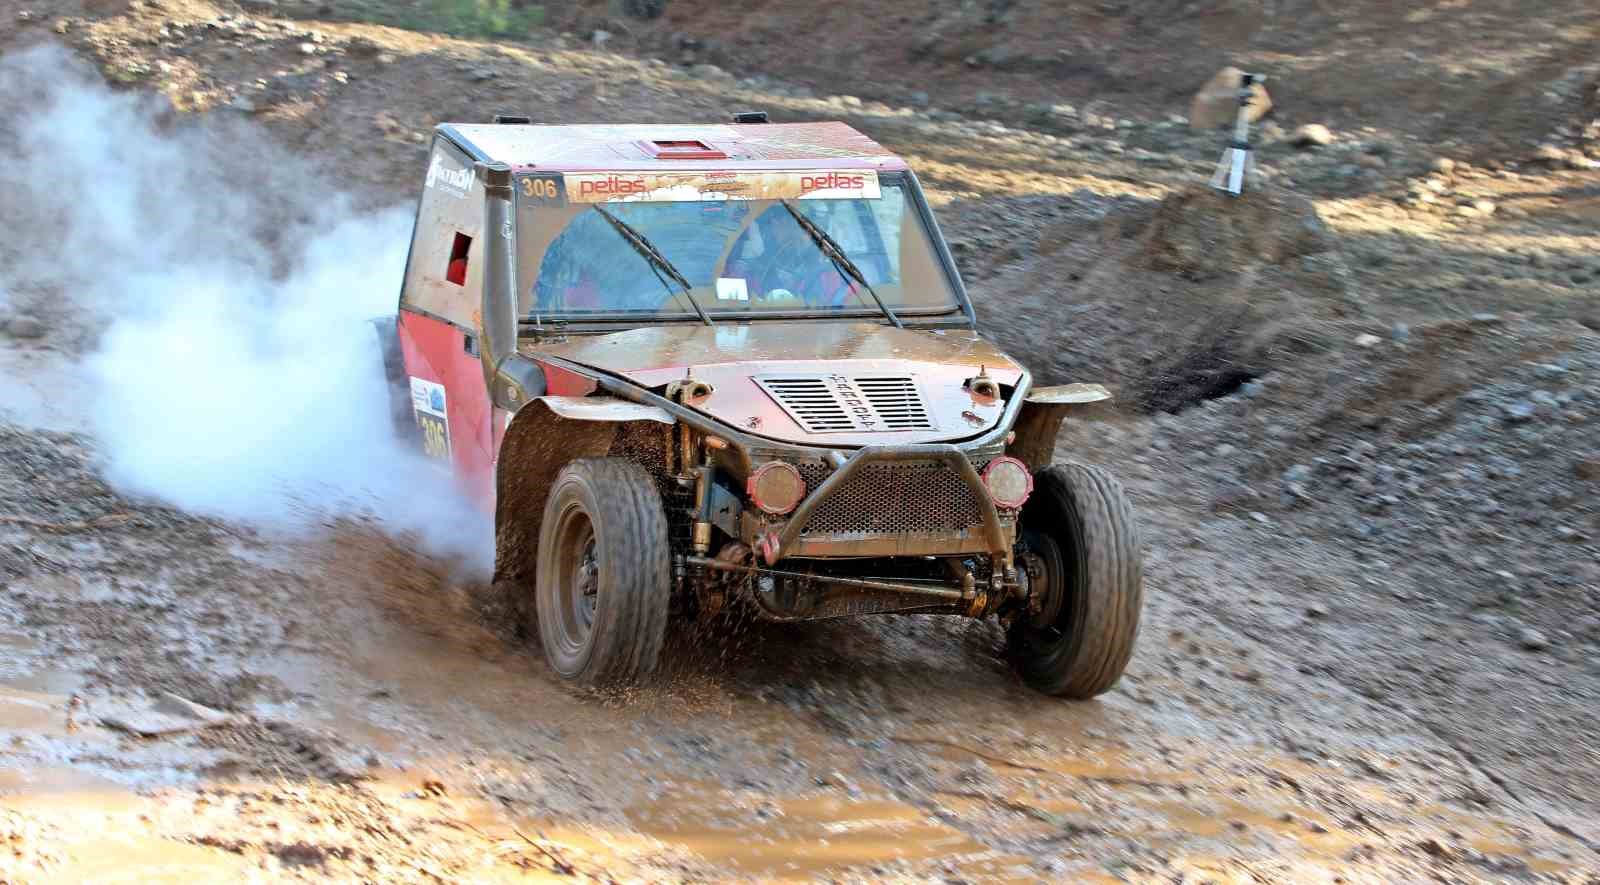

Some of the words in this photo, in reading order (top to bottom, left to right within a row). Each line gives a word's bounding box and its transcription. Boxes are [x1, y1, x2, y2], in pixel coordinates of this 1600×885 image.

[521, 176, 558, 199] 306
[579, 175, 646, 198] petlas
[800, 172, 865, 191] petlas
